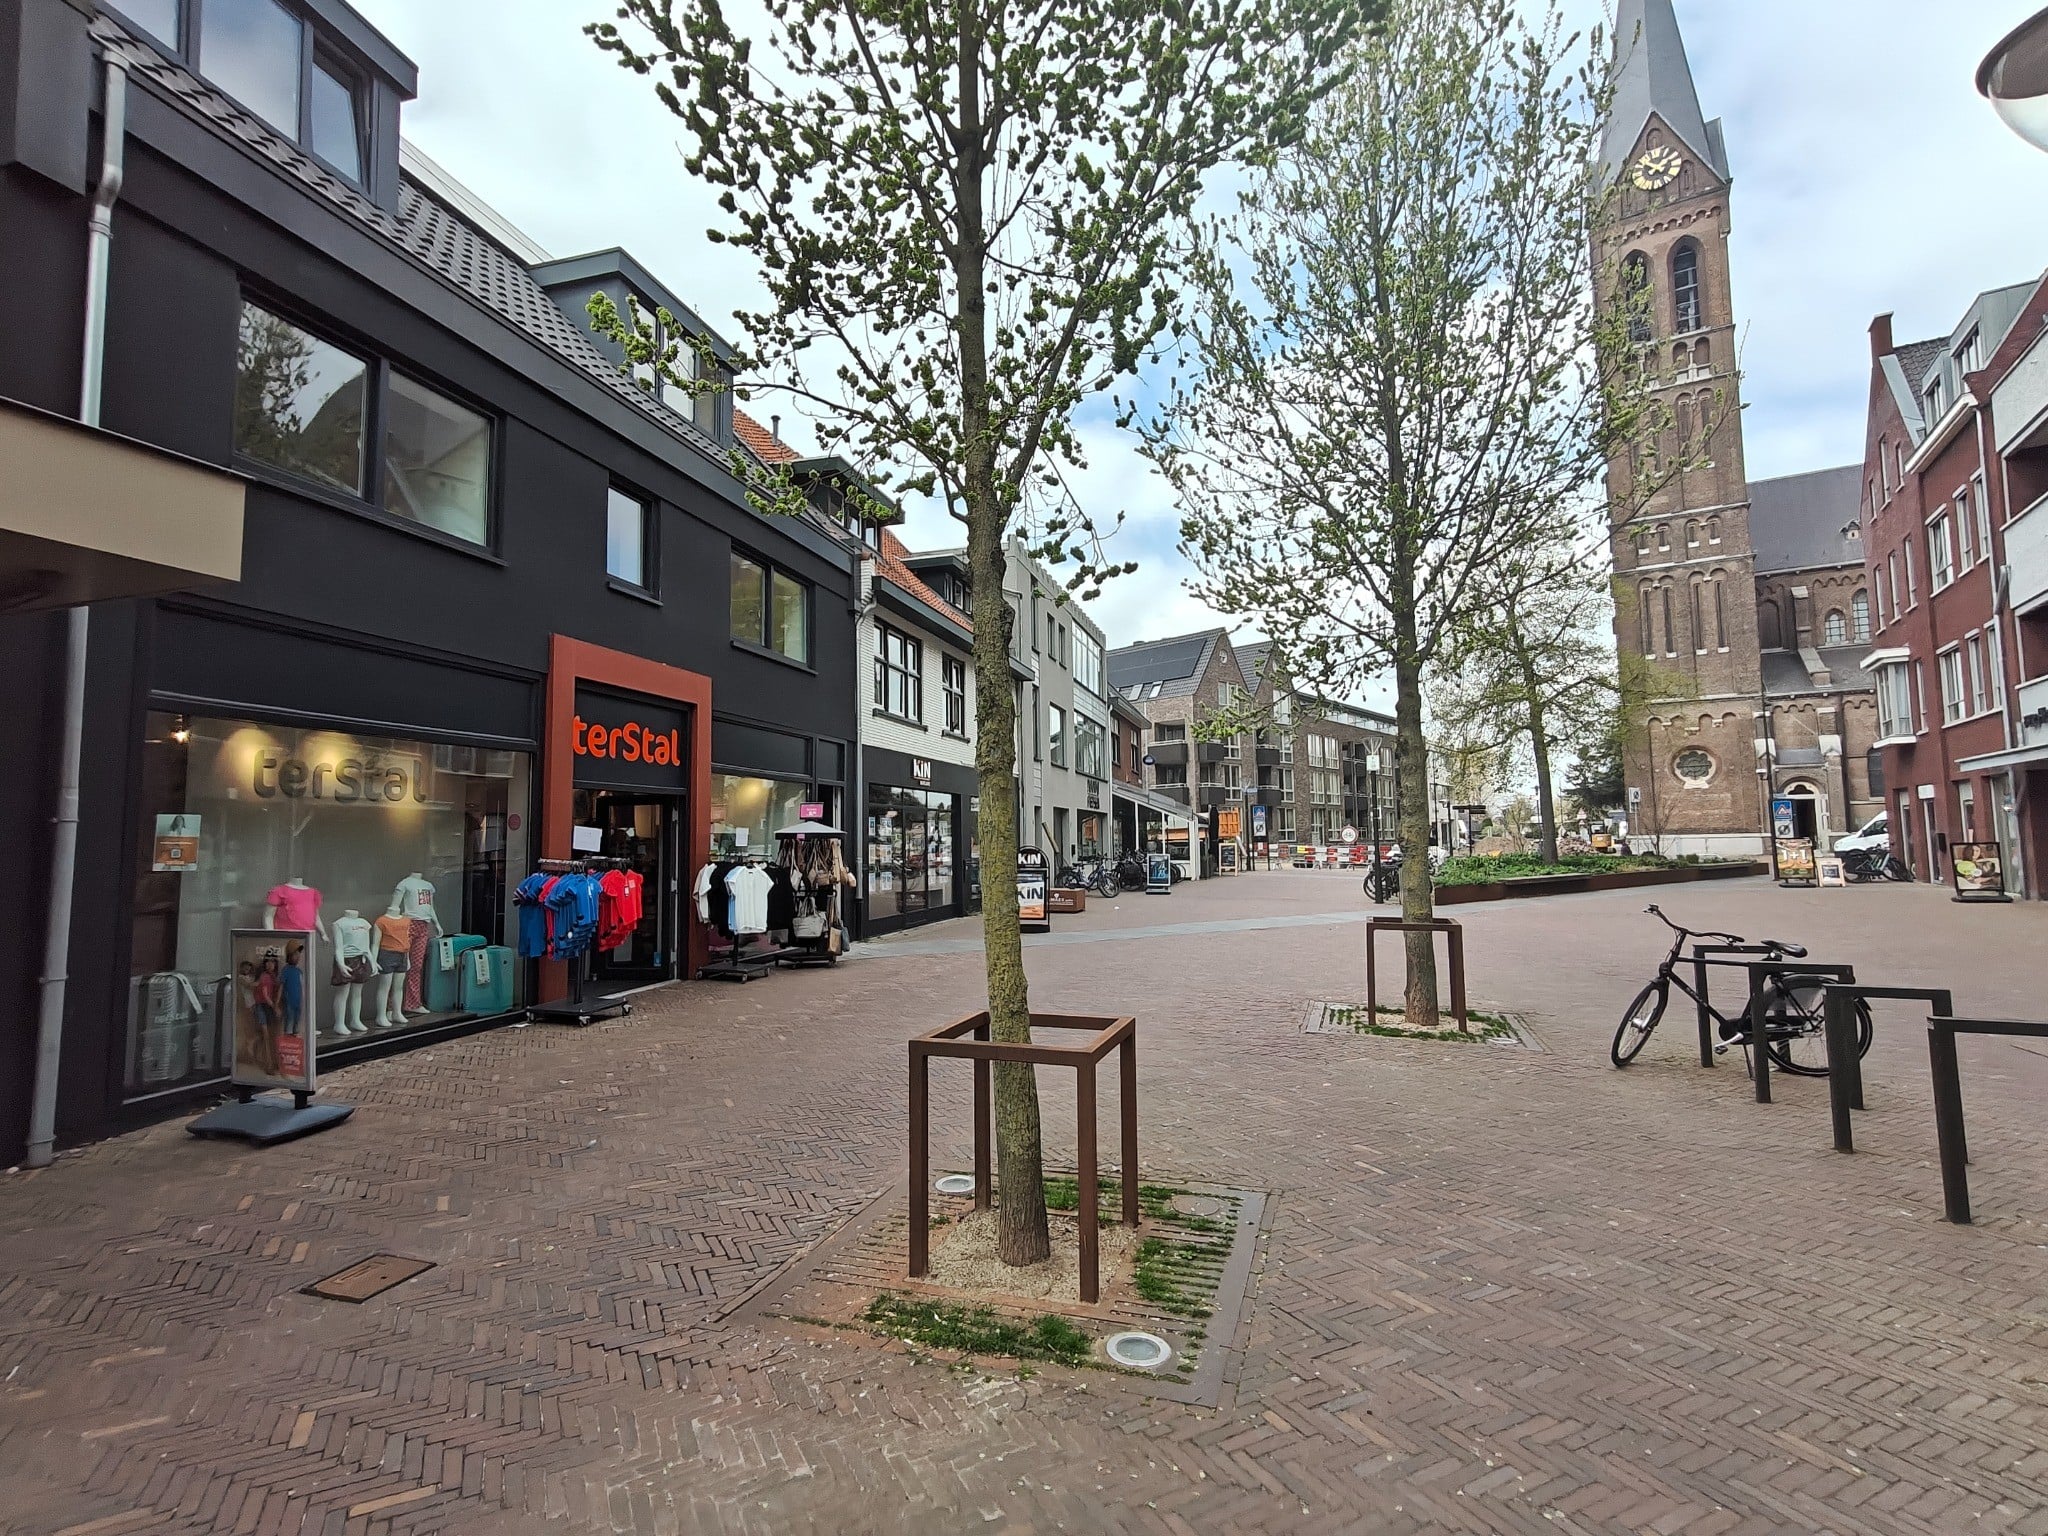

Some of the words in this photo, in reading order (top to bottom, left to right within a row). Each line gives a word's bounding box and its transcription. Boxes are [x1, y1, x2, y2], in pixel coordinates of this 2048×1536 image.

[573, 715, 680, 767] terStal
[253, 749, 427, 803] terStal
[1781, 849, 1808, 861] 1+1
